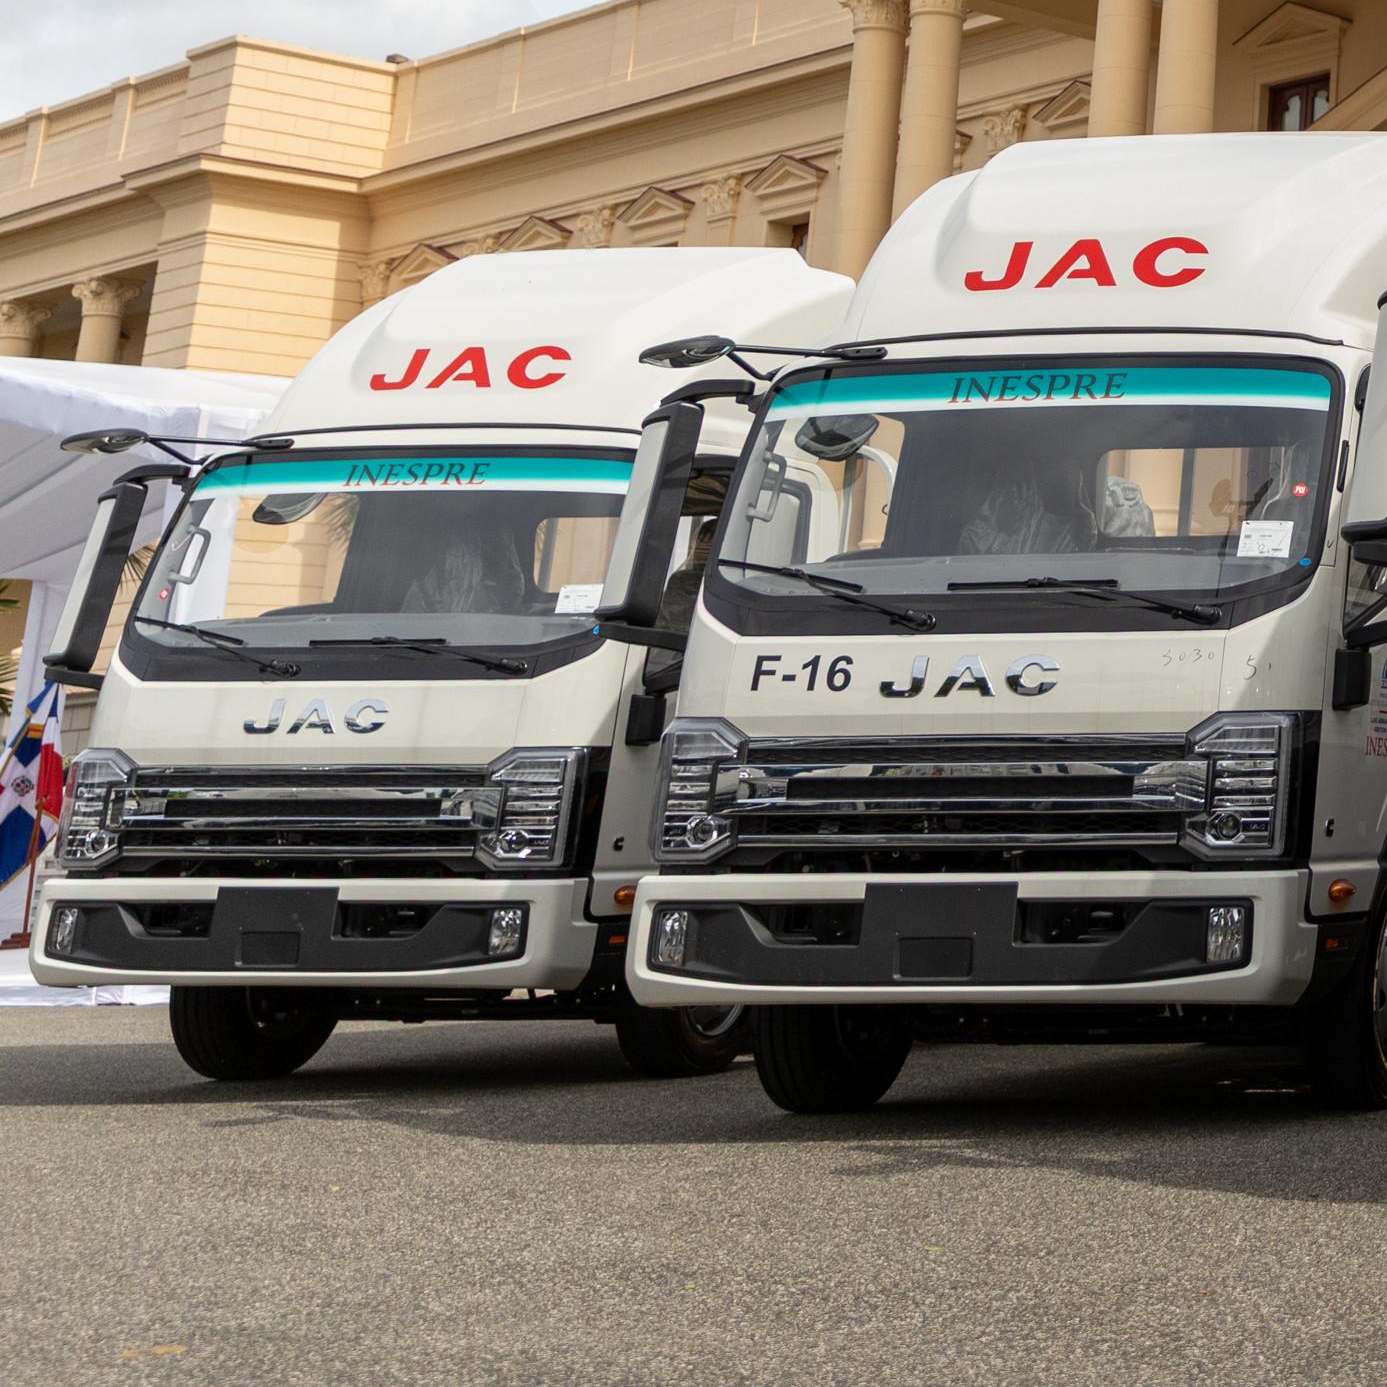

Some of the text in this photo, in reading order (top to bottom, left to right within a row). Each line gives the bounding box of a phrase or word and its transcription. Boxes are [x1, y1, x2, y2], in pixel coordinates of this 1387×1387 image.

[964, 236, 1210, 292] JAC
[370, 345, 572, 391] JAC
[947, 372, 1128, 404] INESPRE
[342, 462, 491, 487] INESPRE
[750, 654, 854, 692] F-16
[879, 654, 1061, 697] JAC
[242, 698, 389, 734] JAC
